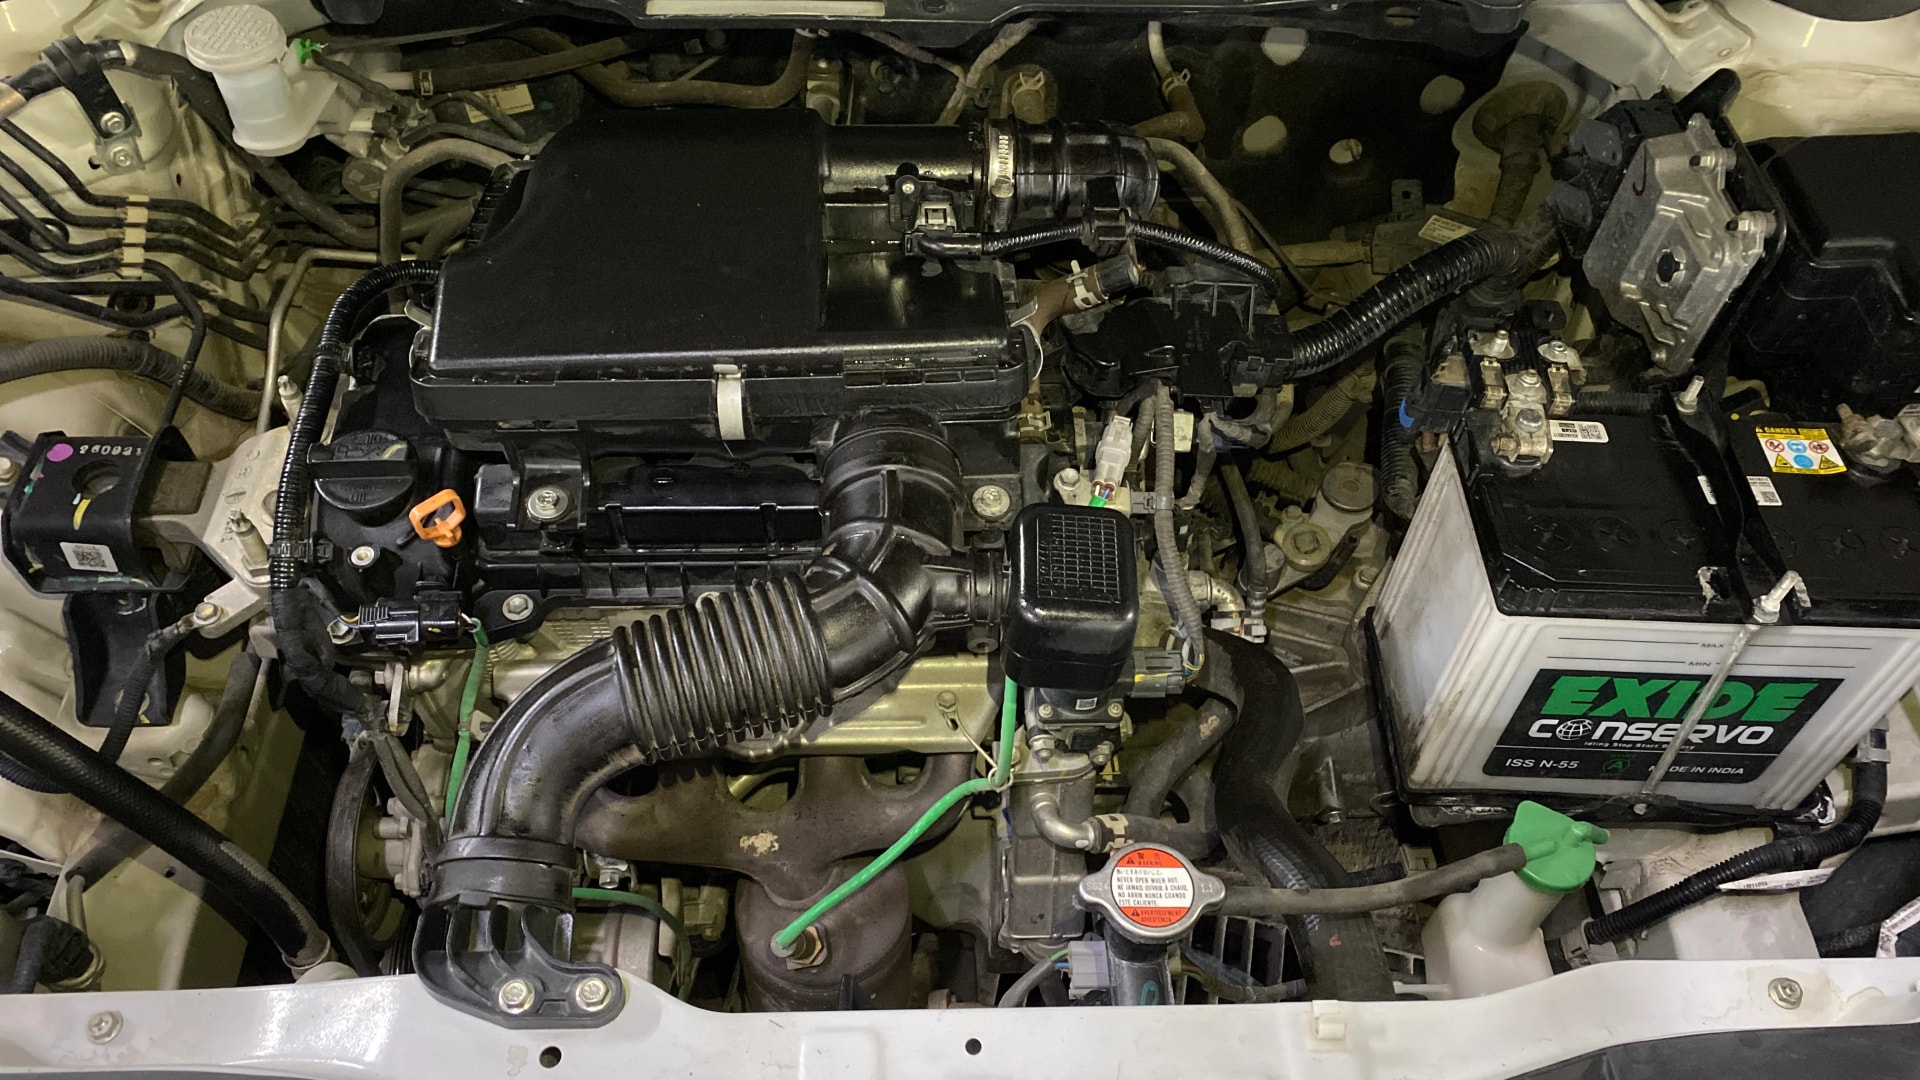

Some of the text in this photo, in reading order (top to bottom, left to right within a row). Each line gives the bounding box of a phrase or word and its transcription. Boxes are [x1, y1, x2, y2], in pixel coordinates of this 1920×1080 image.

[1540, 676, 1820, 722] EXIDE
[1505, 758, 1580, 769] ISS N-55
[1707, 767, 1744, 775] INDIA
